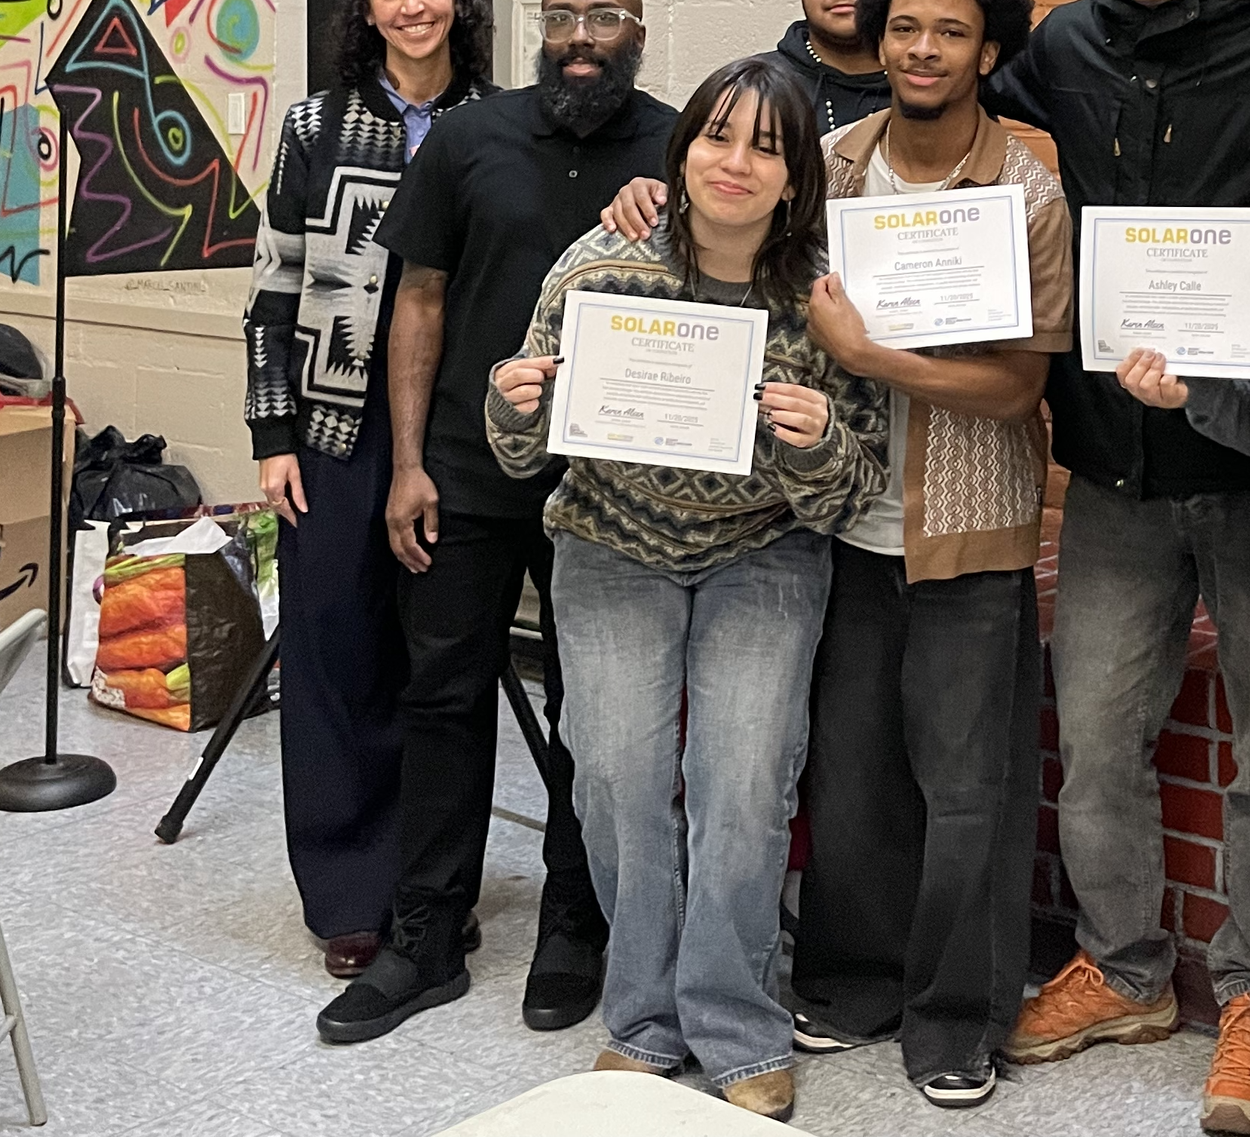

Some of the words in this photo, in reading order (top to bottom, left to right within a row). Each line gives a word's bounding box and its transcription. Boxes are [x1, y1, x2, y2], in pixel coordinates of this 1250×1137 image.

[897, 227, 959, 241] CERTIFICATE
[1146, 247, 1208, 258] CERTIFICATE
[894, 260, 933, 271] Cameron
[1148, 280, 1178, 292] Ashley
[631, 337, 695, 353] CERTIFICATE
[660, 371, 691, 385] Ribeiro
